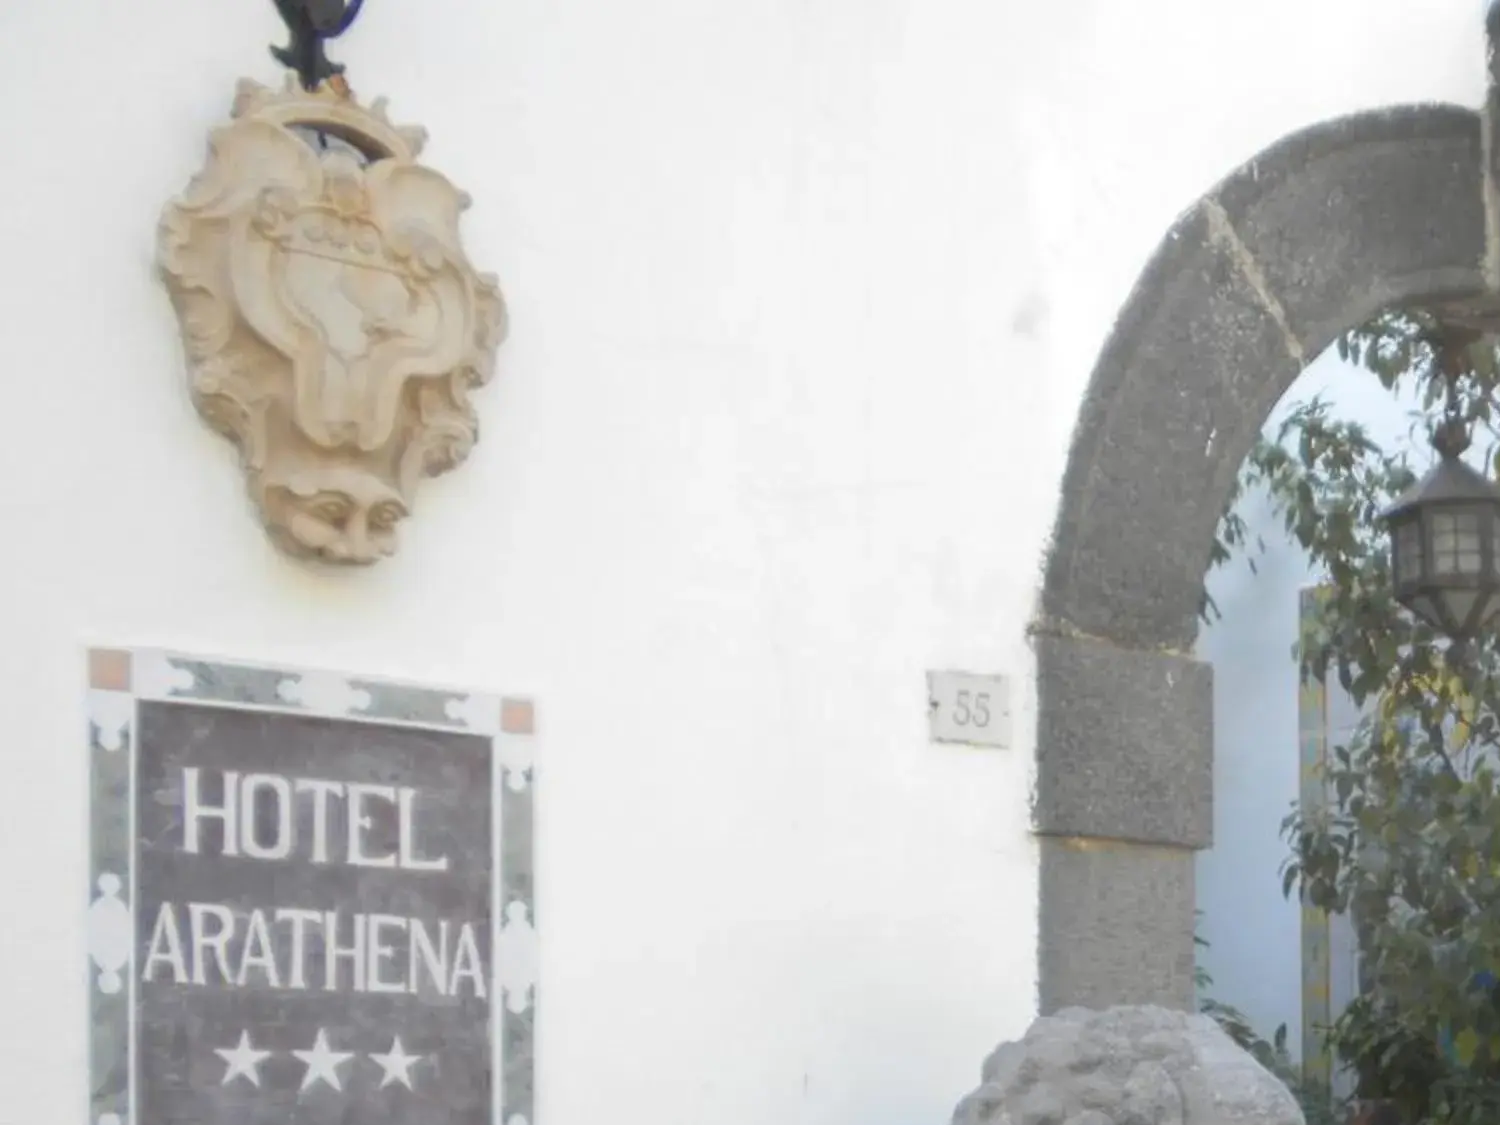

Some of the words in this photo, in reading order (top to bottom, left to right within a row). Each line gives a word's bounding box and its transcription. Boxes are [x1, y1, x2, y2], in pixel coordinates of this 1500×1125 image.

[952, 689, 991, 728] 55
[181, 767, 448, 870] HOTEL
[141, 901, 488, 998] ARATHENA
